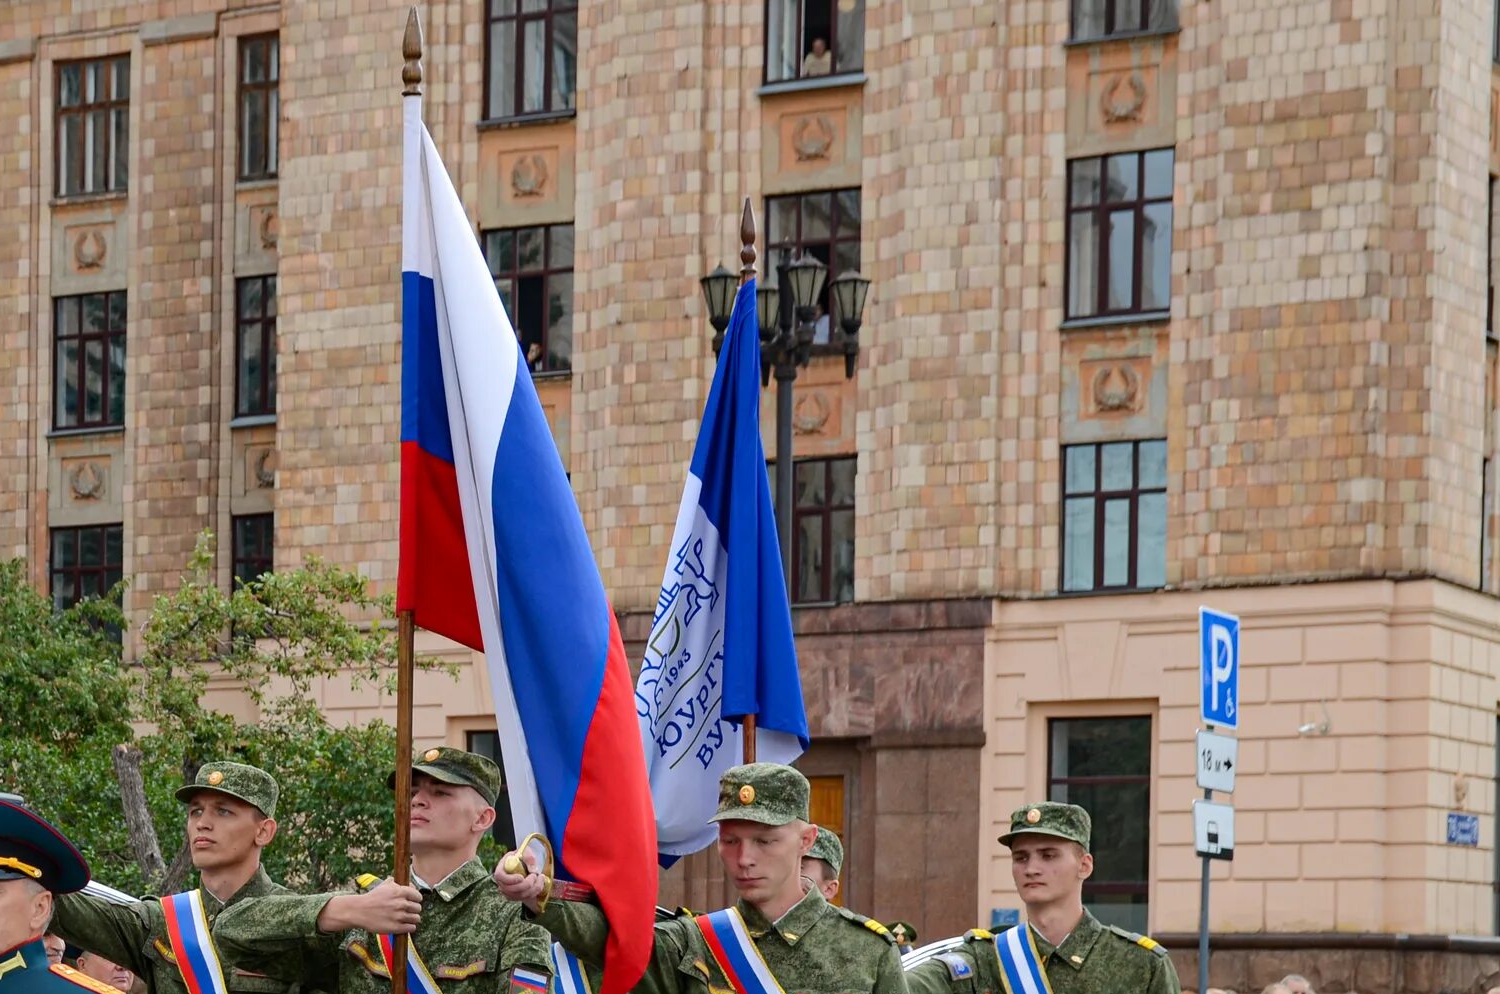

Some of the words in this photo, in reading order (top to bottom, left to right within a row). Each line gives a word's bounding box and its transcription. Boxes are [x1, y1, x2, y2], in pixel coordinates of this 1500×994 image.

[664, 648, 691, 687] 1943
[1211, 623, 1233, 712] P
[657, 648, 724, 757] ЮУрГ
[1202, 749, 1212, 772] 18
